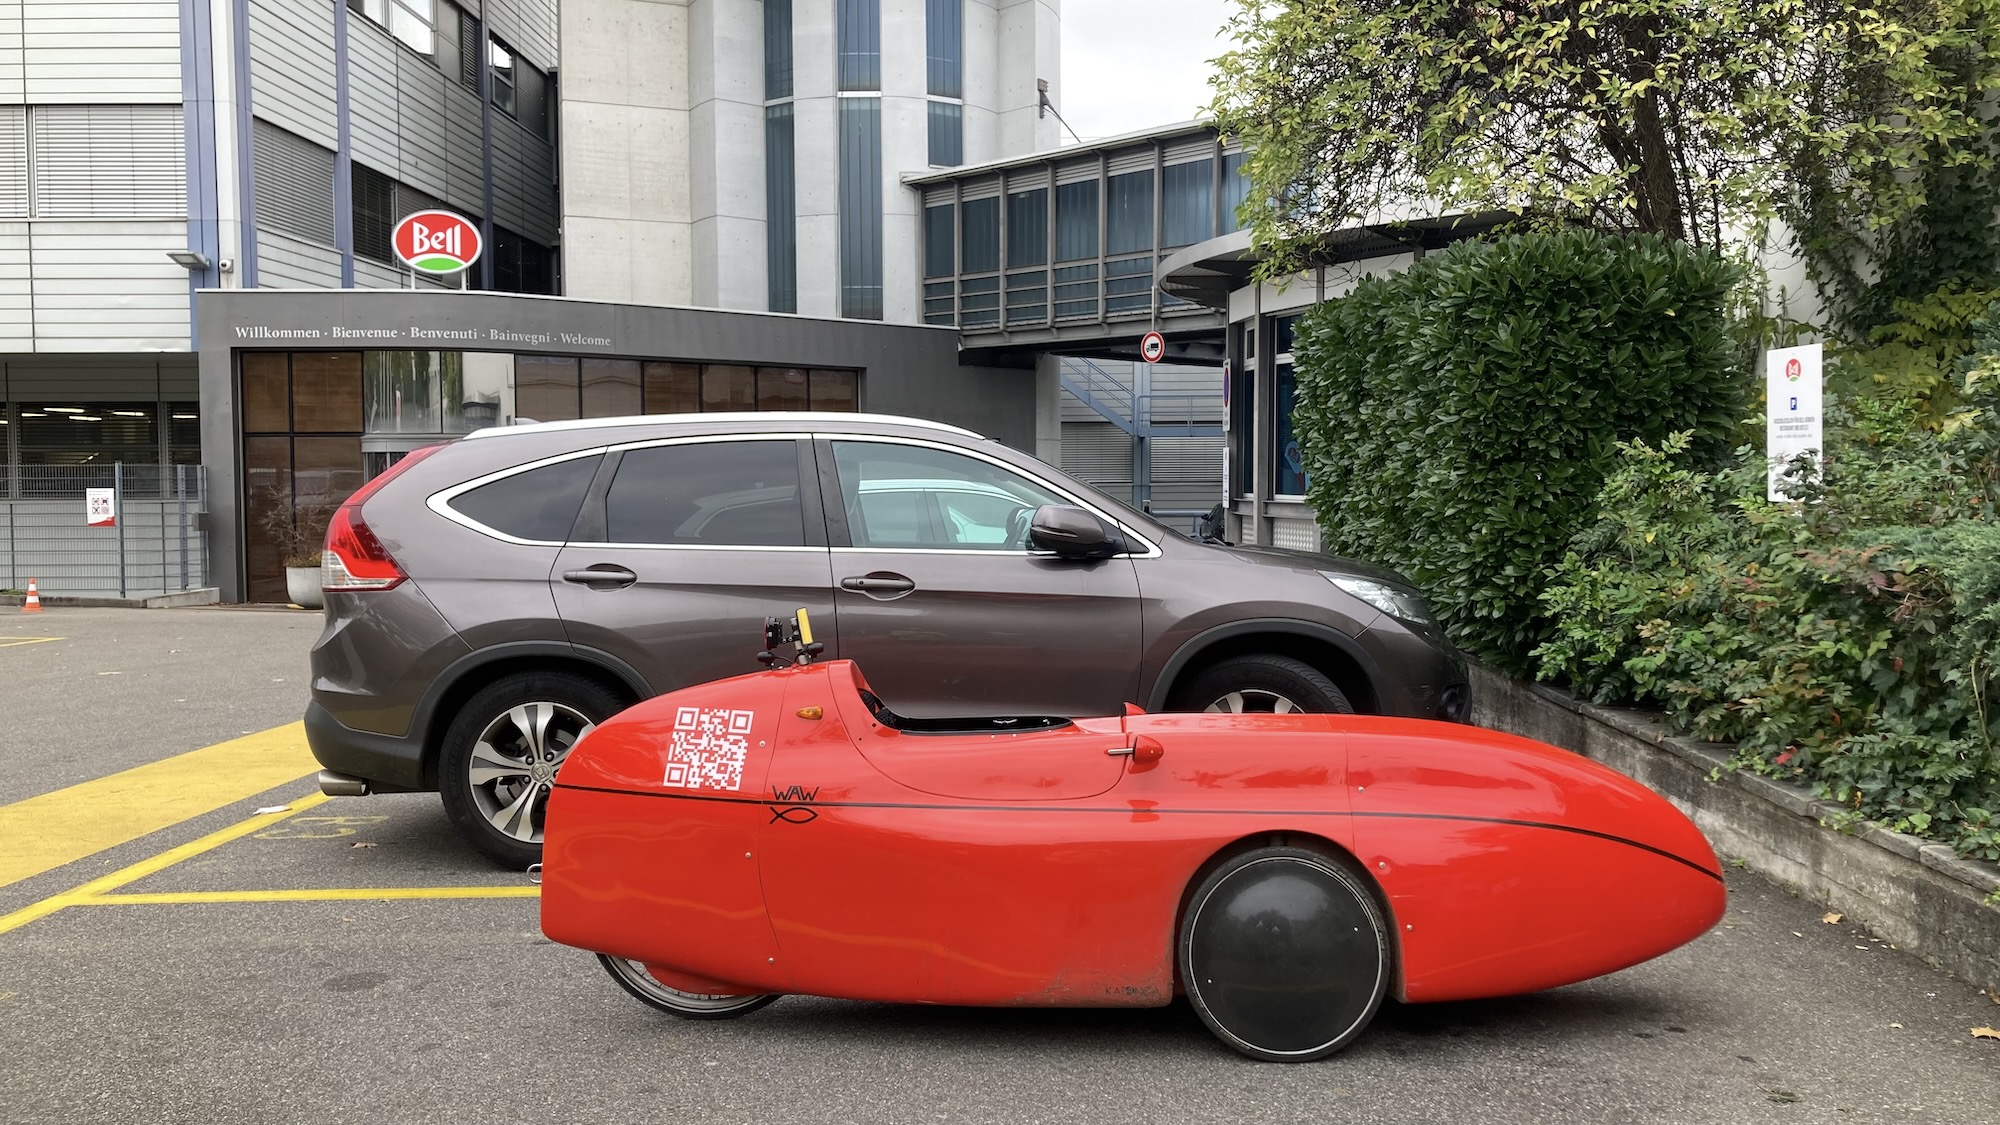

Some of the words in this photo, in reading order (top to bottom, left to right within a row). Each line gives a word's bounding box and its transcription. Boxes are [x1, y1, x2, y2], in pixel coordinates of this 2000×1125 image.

[413, 221, 461, 256] Bell
[235, 326, 320, 339] Willkommen
[332, 326, 398, 340] Bienvenue
[410, 326, 478, 341] Benvenuti
[489, 329, 551, 345] Bainvegni
[560, 332, 611, 347] Welcome
[772, 785, 819, 801] WAW
